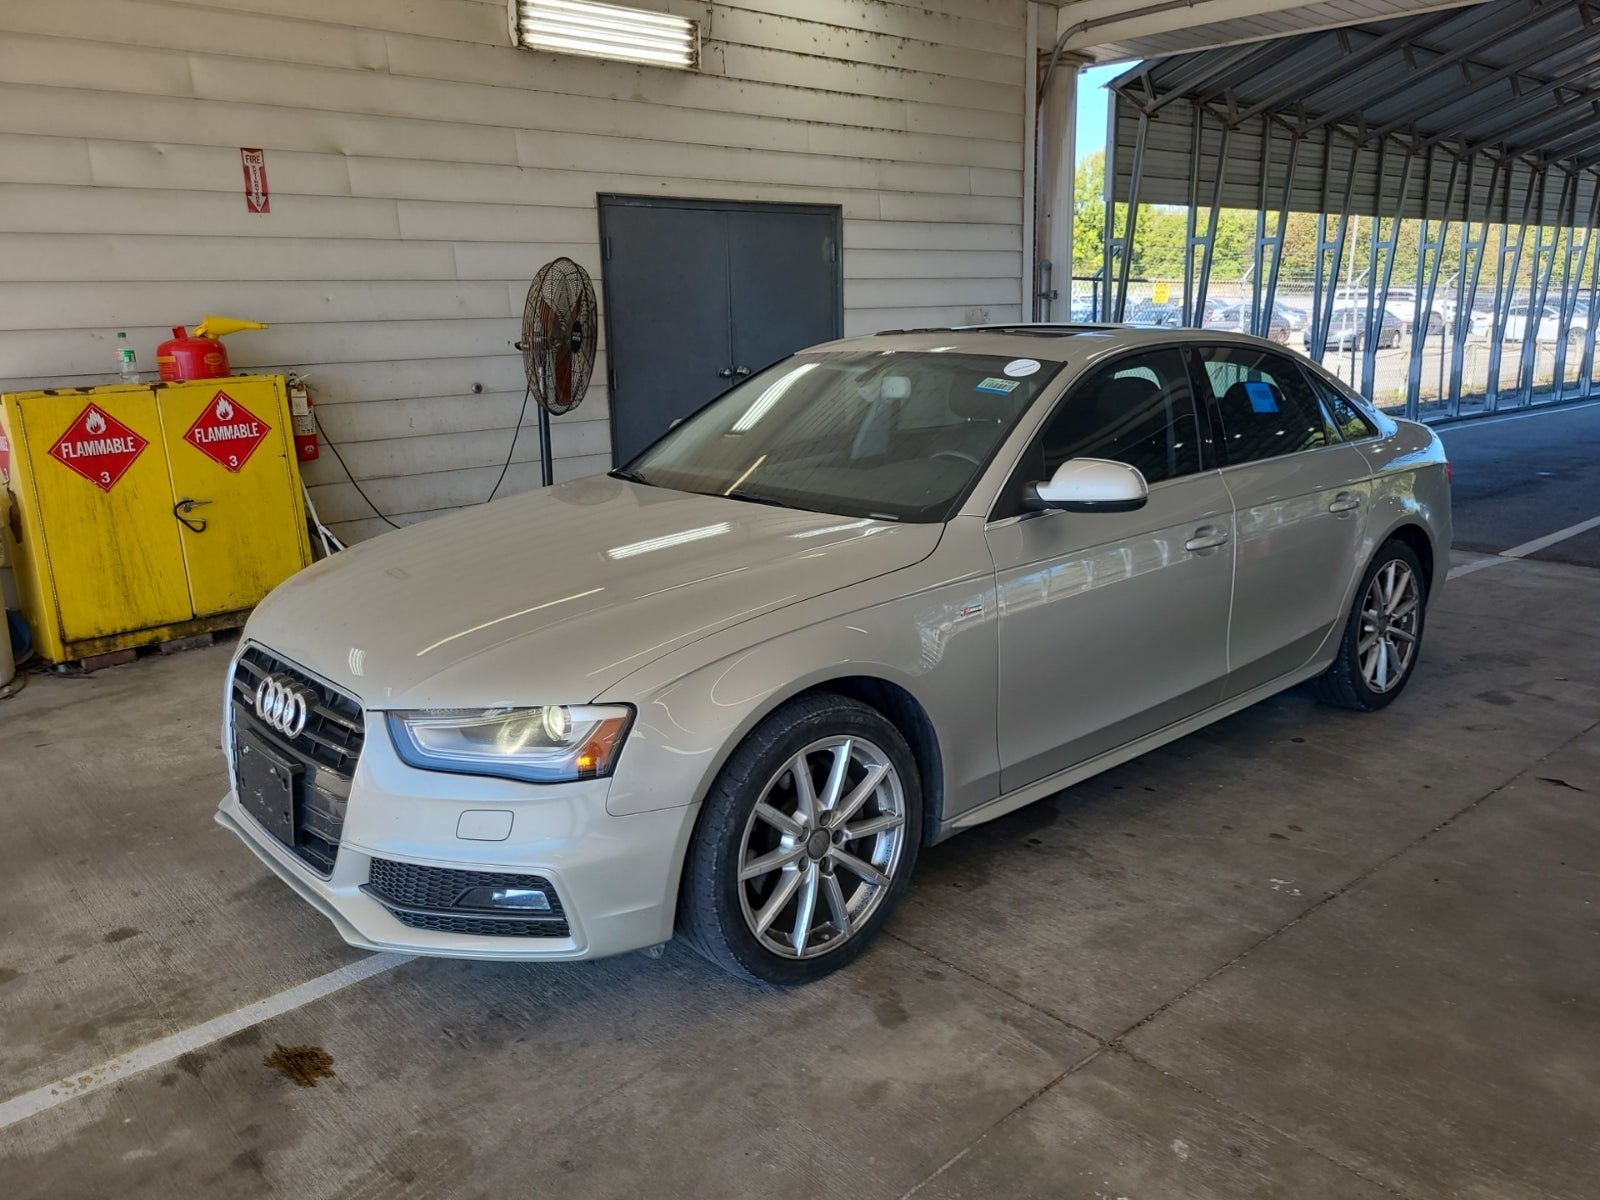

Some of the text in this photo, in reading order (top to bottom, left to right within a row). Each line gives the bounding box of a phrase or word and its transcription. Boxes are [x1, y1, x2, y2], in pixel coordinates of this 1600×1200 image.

[245, 154, 261, 164] FIRE
[194, 422, 260, 443] FLAMMABLE
[61, 436, 136, 459] FLAMMABLE
[229, 455, 238, 467] 3
[100, 471, 111, 483] 3
